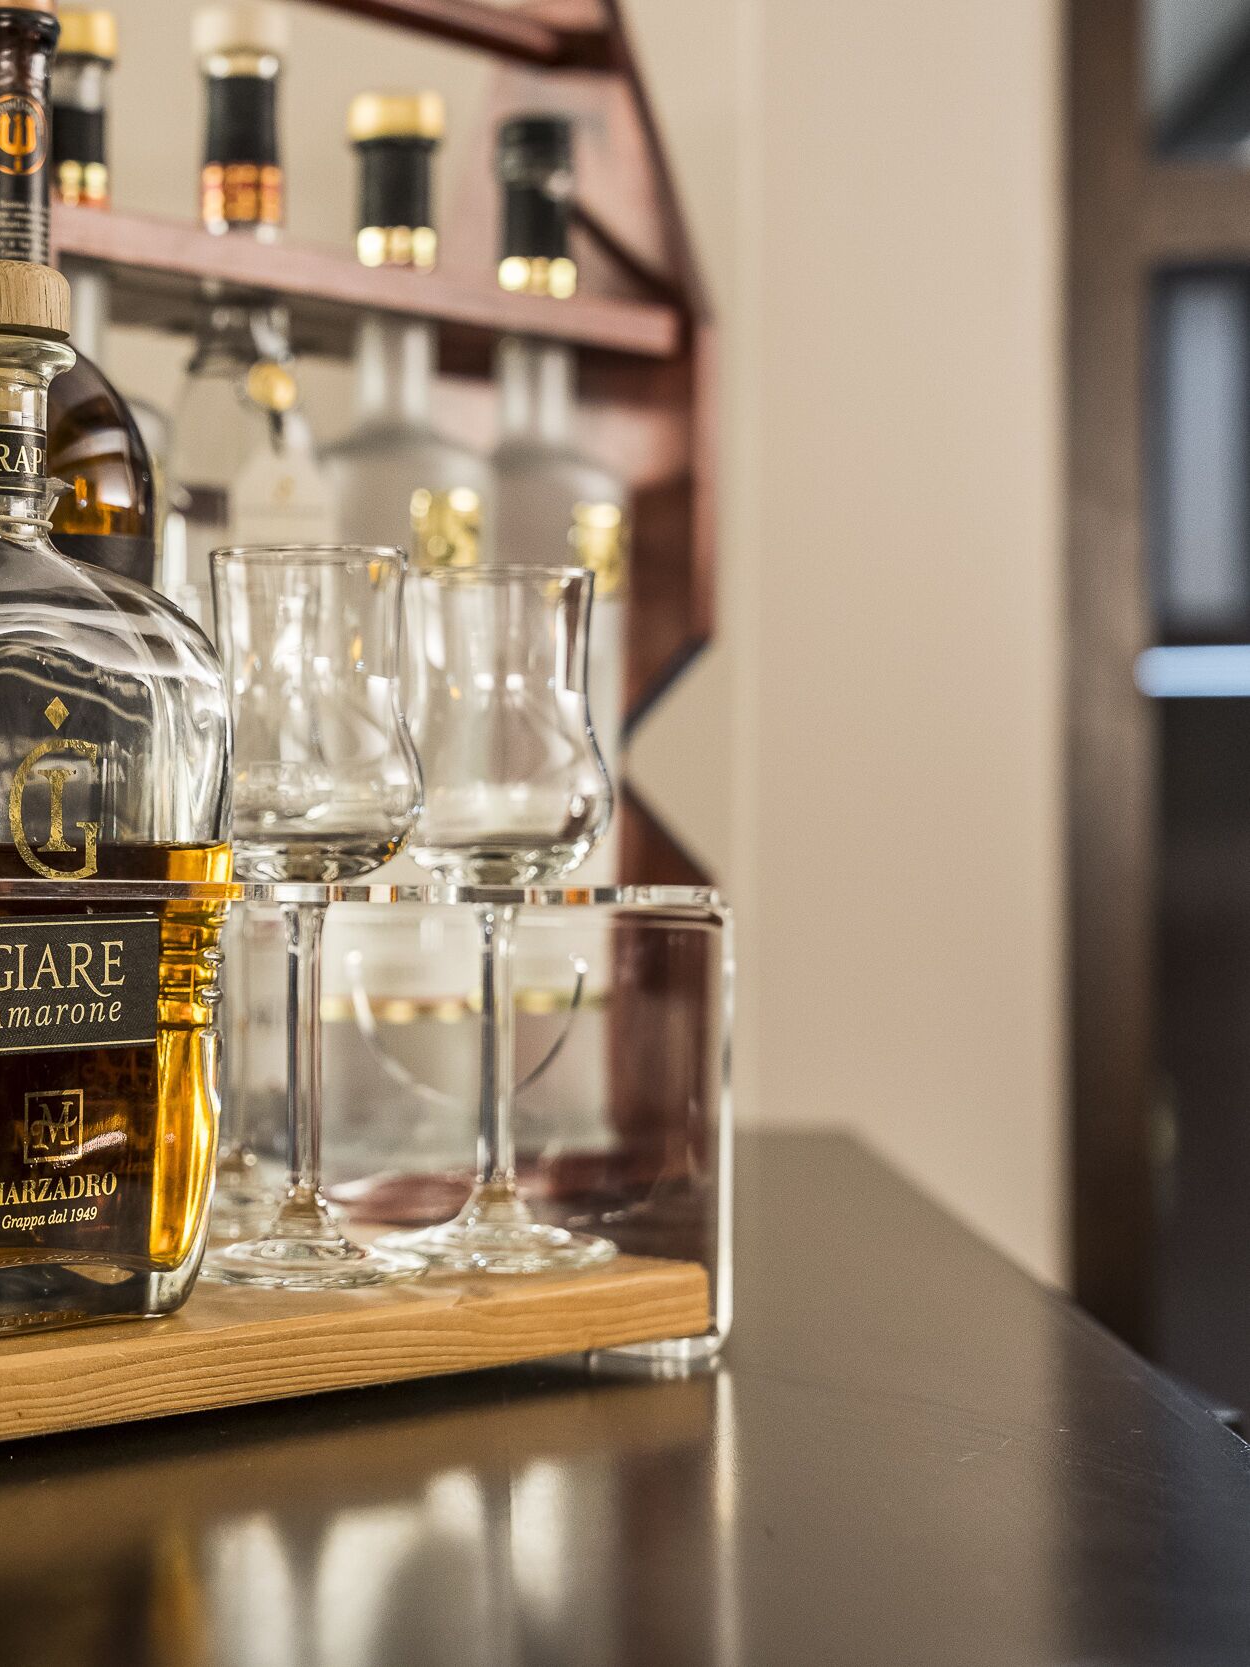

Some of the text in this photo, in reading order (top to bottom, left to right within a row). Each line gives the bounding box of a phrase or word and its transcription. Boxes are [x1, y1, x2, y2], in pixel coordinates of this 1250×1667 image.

[1, 1206, 98, 1231] Grappa dal 1949
